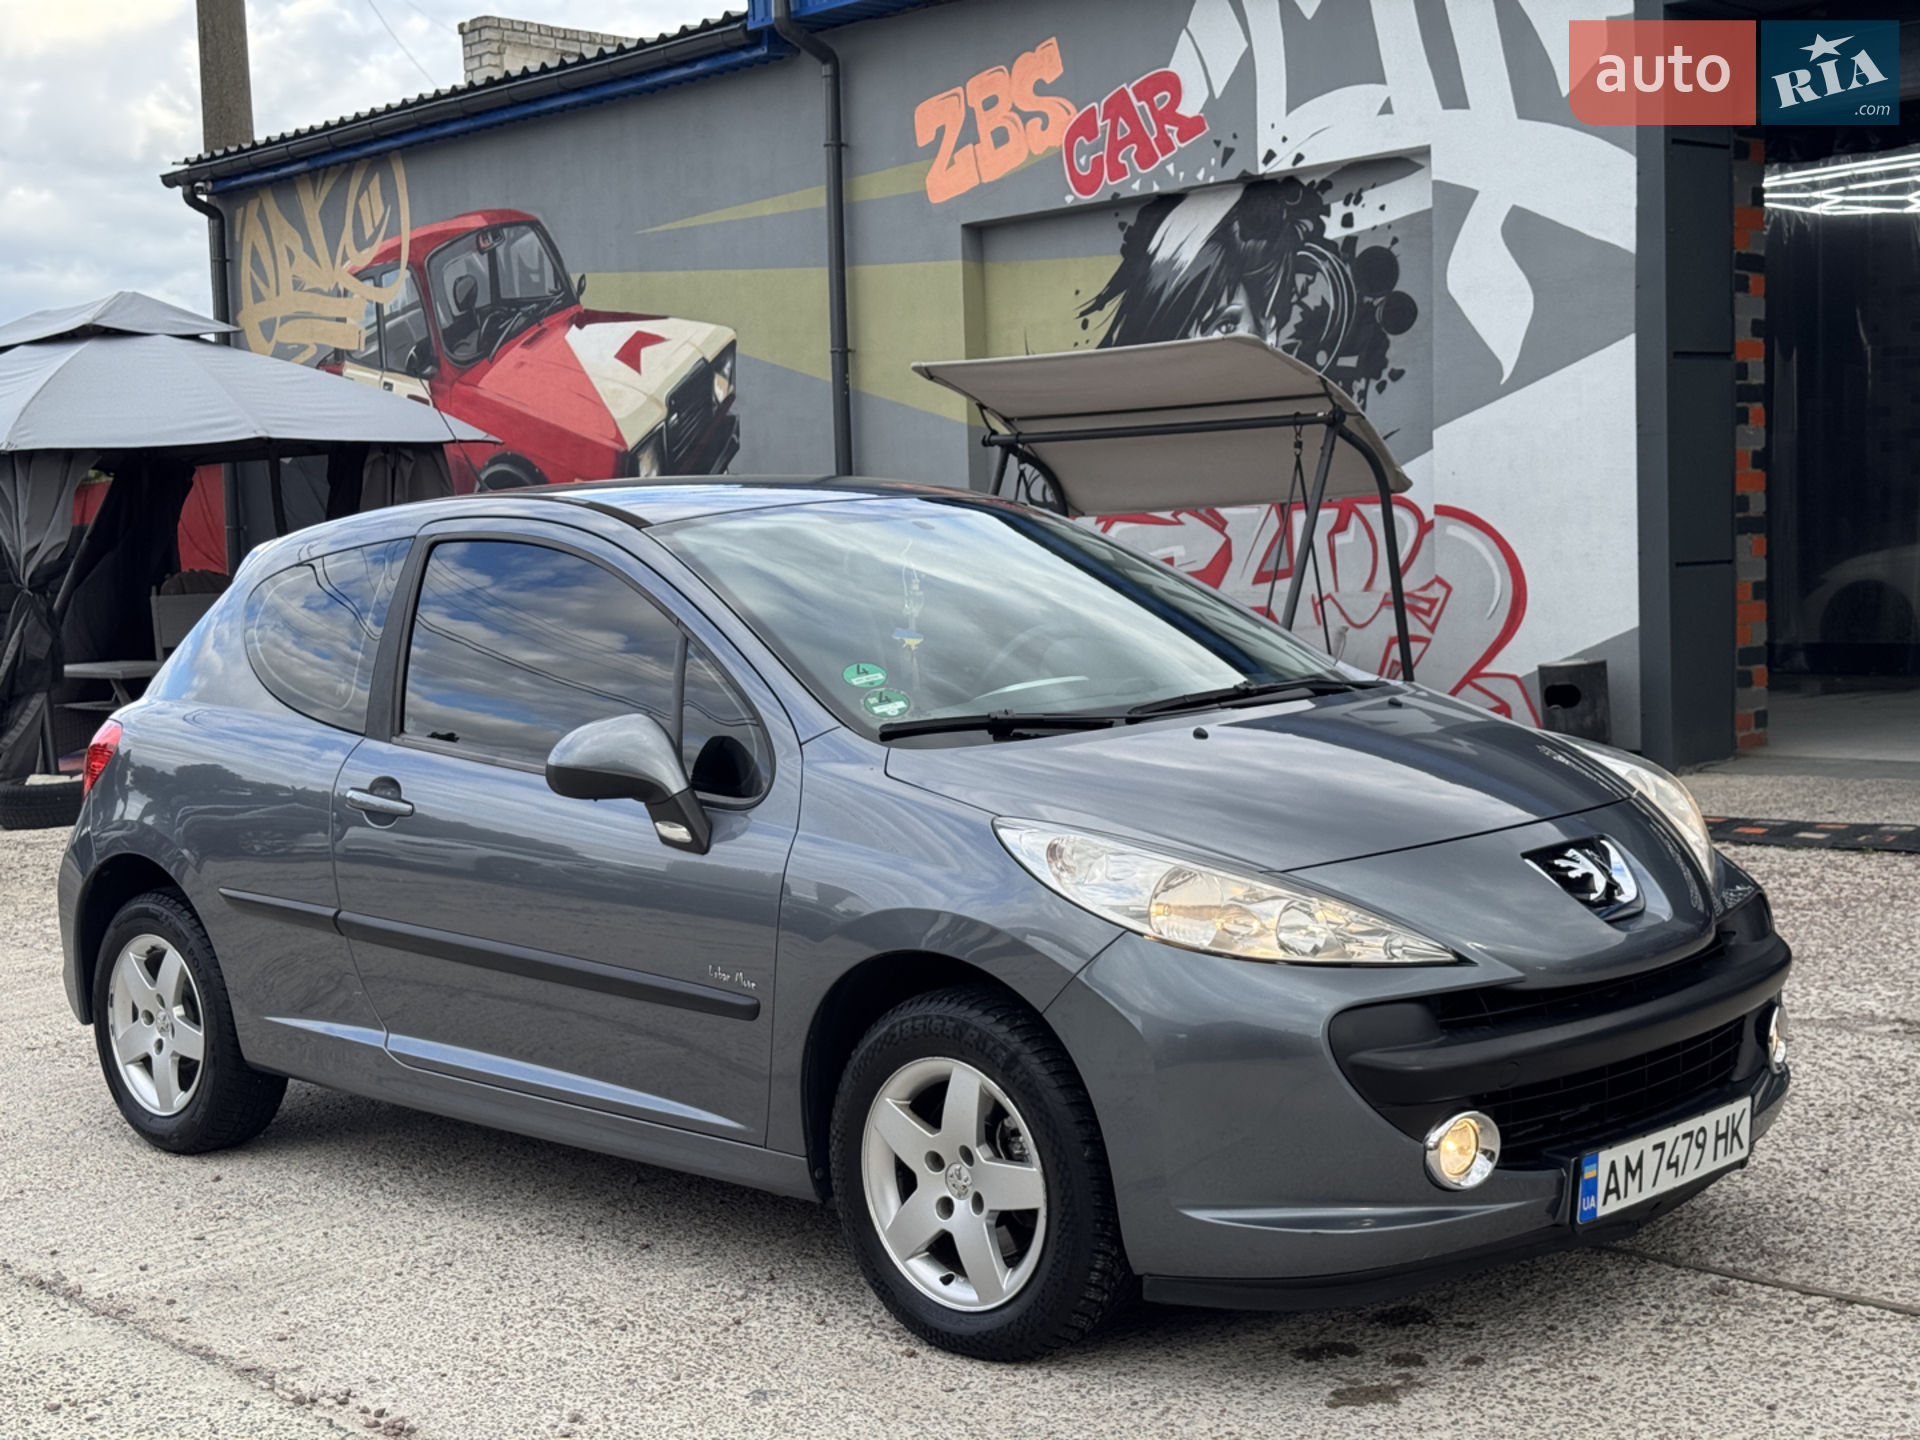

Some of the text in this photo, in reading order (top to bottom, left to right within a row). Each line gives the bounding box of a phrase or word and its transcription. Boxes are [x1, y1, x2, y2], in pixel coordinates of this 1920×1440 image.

[914, 36, 1210, 204] ZBS CAR
[1582, 1196, 1597, 1212] UA
[1602, 1107, 1747, 1207] AM 7479 HK
